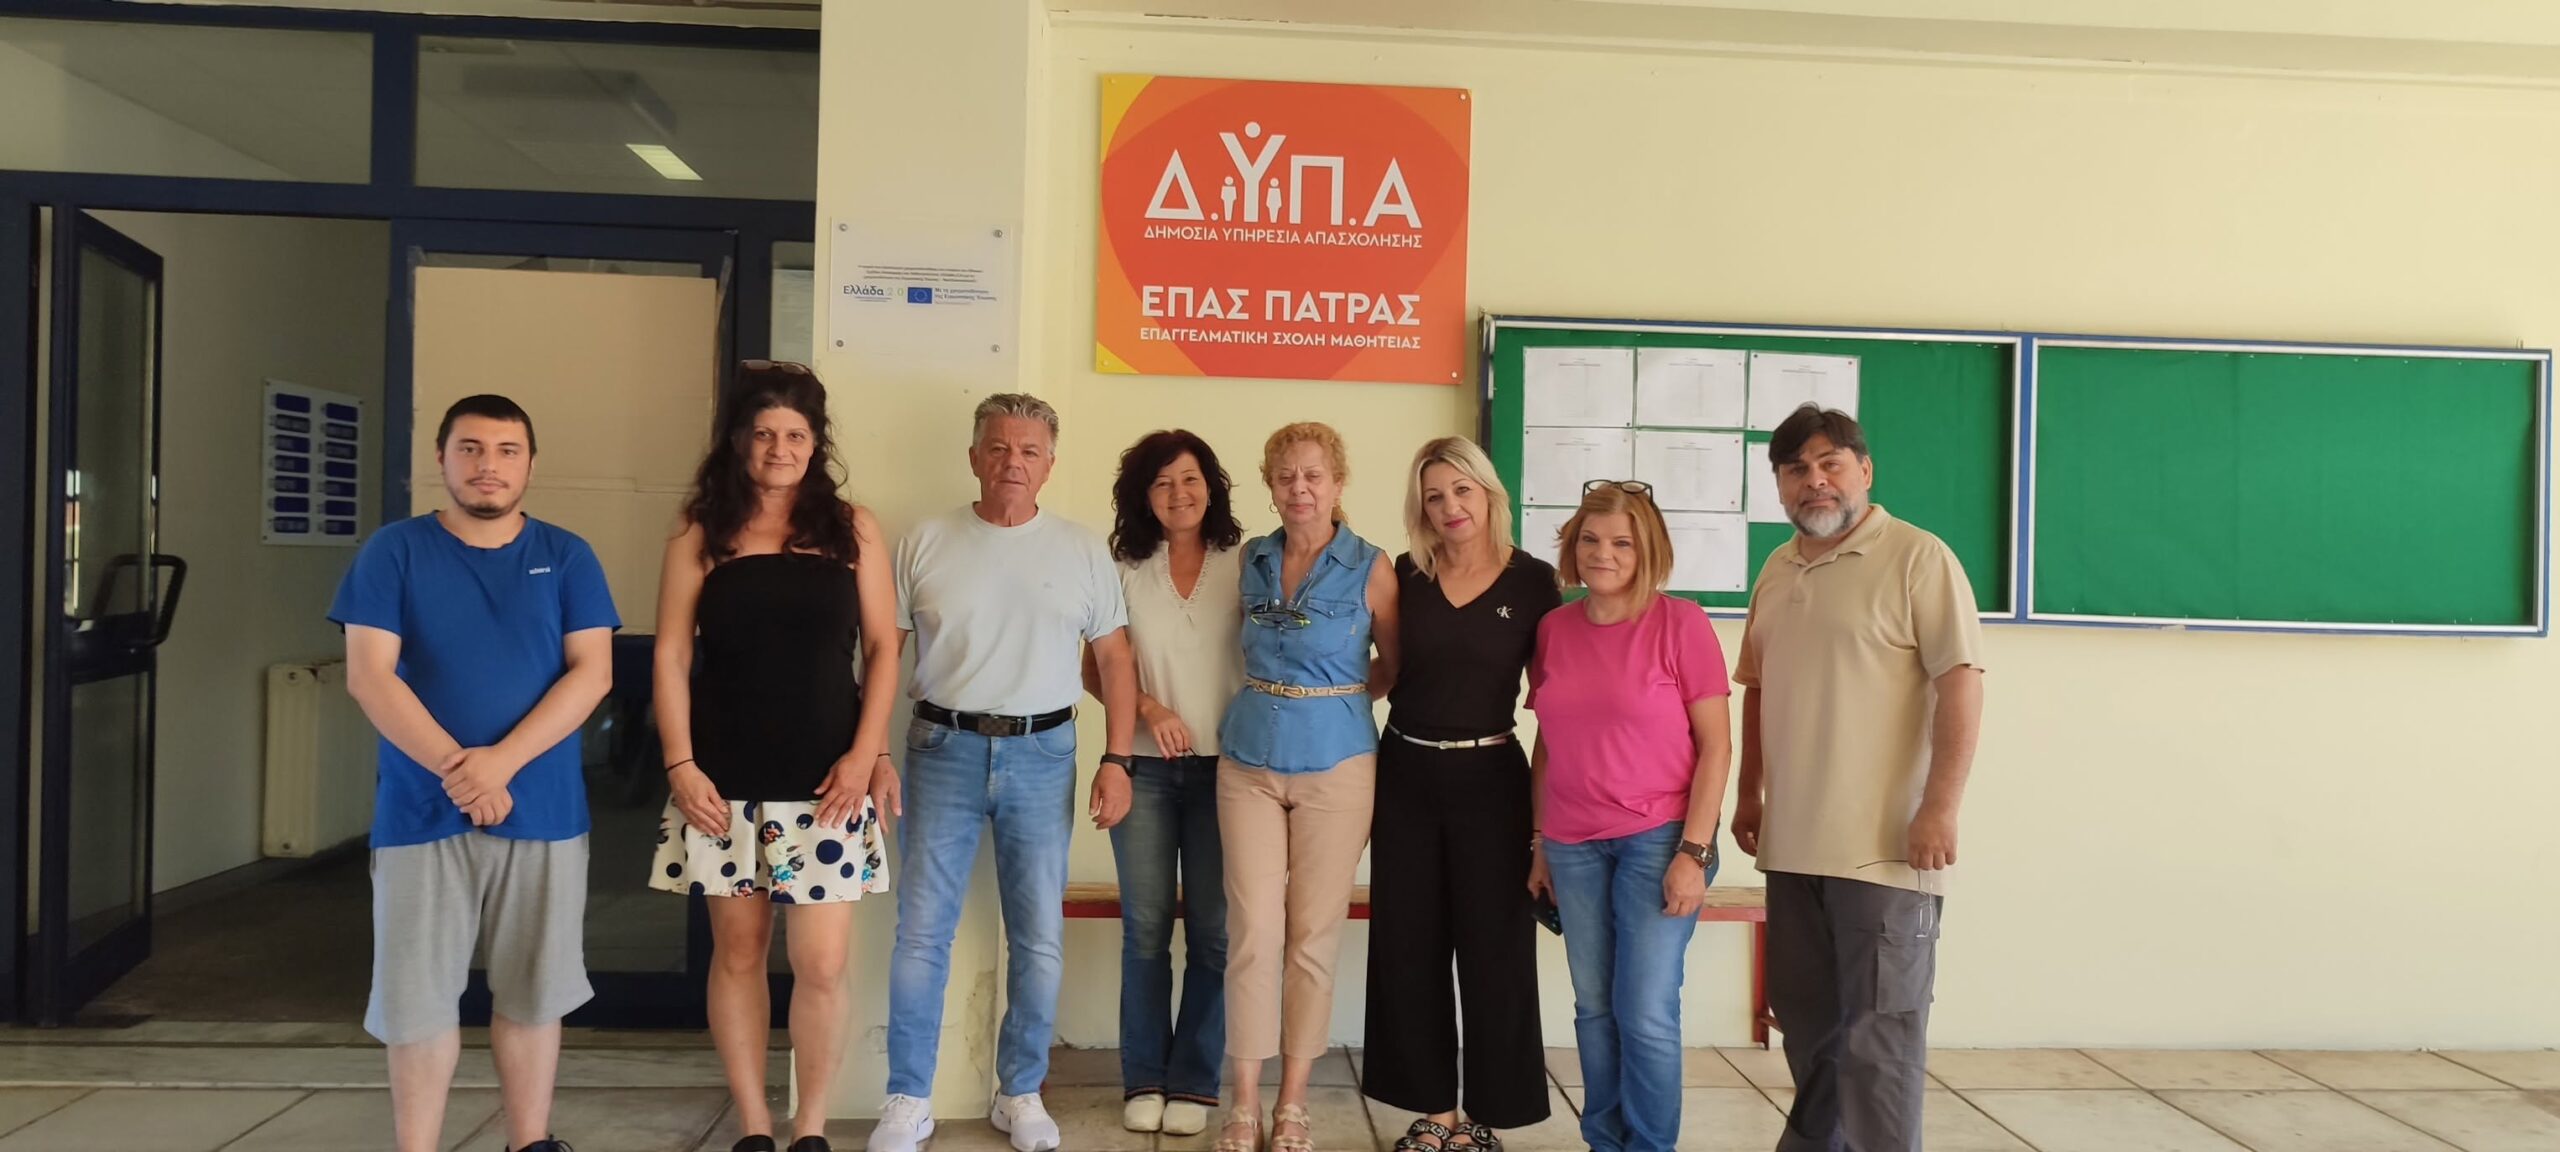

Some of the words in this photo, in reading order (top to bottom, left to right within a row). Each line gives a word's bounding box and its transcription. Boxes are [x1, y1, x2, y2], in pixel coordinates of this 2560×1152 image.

[1144, 224, 1219, 241] ΔΗΜΟΣΙΑ
[1222, 227, 1301, 244] ΥΠΗΡΕΣΙΑ
[1303, 231, 1423, 248] ΑΠΑΣΧΟΛΗΣΗΣ
[843, 284, 884, 296] Ελλάδα
[1142, 285, 1249, 320] ΕΠΑΣ
[1265, 290, 1420, 325] ΠΑΤΡΑΣ
[1140, 327, 1268, 344] ΕΠΑΓΓΕΛΜΑΤΙΚΗ
[1272, 332, 1326, 347] ΣΧΟΛΗ
[1331, 334, 1421, 349] ΜΑΘΗΤΕΙΑΣ
